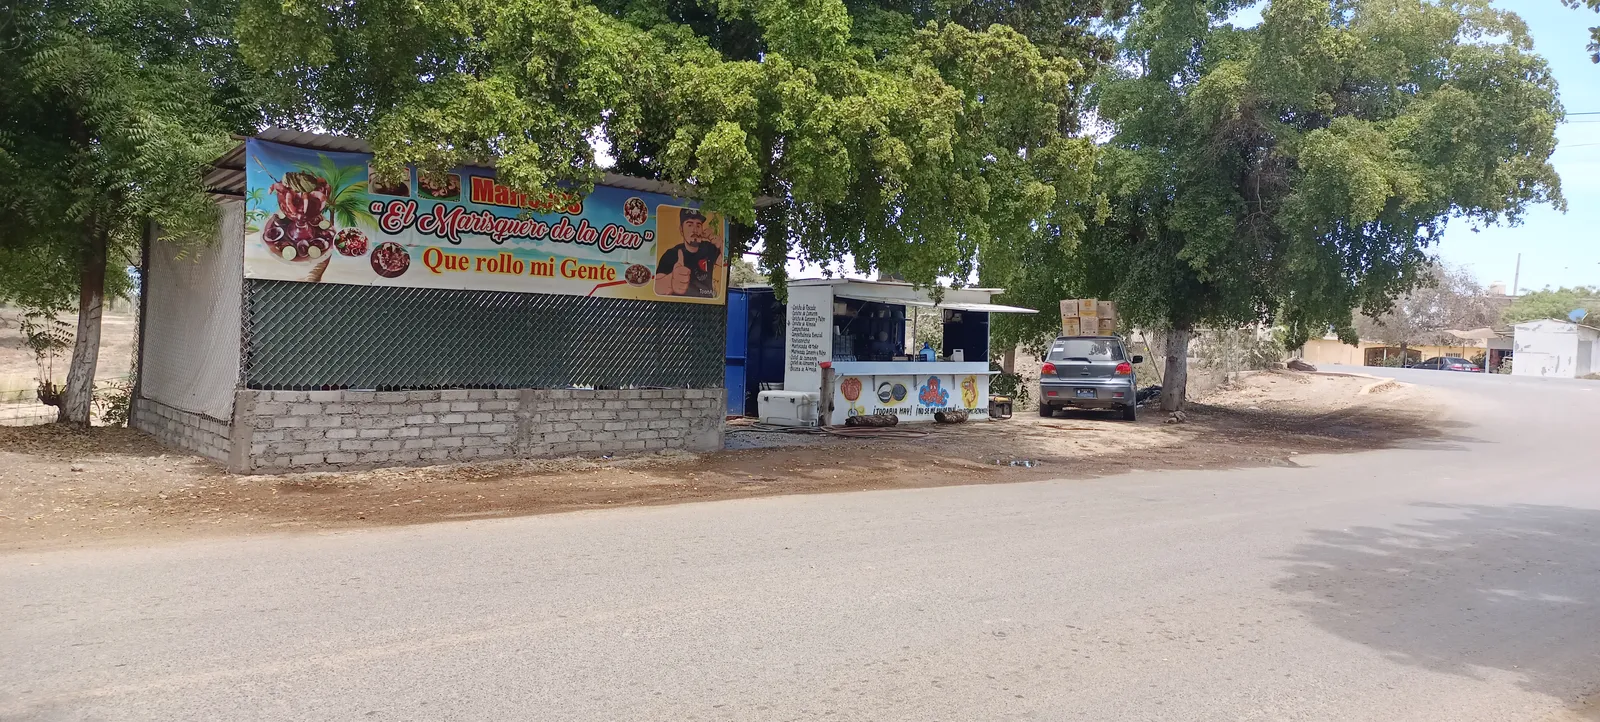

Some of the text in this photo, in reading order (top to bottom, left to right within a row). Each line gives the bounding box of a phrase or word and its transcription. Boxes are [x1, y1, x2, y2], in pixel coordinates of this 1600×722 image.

[471, 176, 582, 214] Maris
[417, 204, 549, 244] Marisquero
[550, 217, 576, 243] de
[577, 219, 598, 244] la
[423, 247, 616, 281] Que rollo mi Gente
